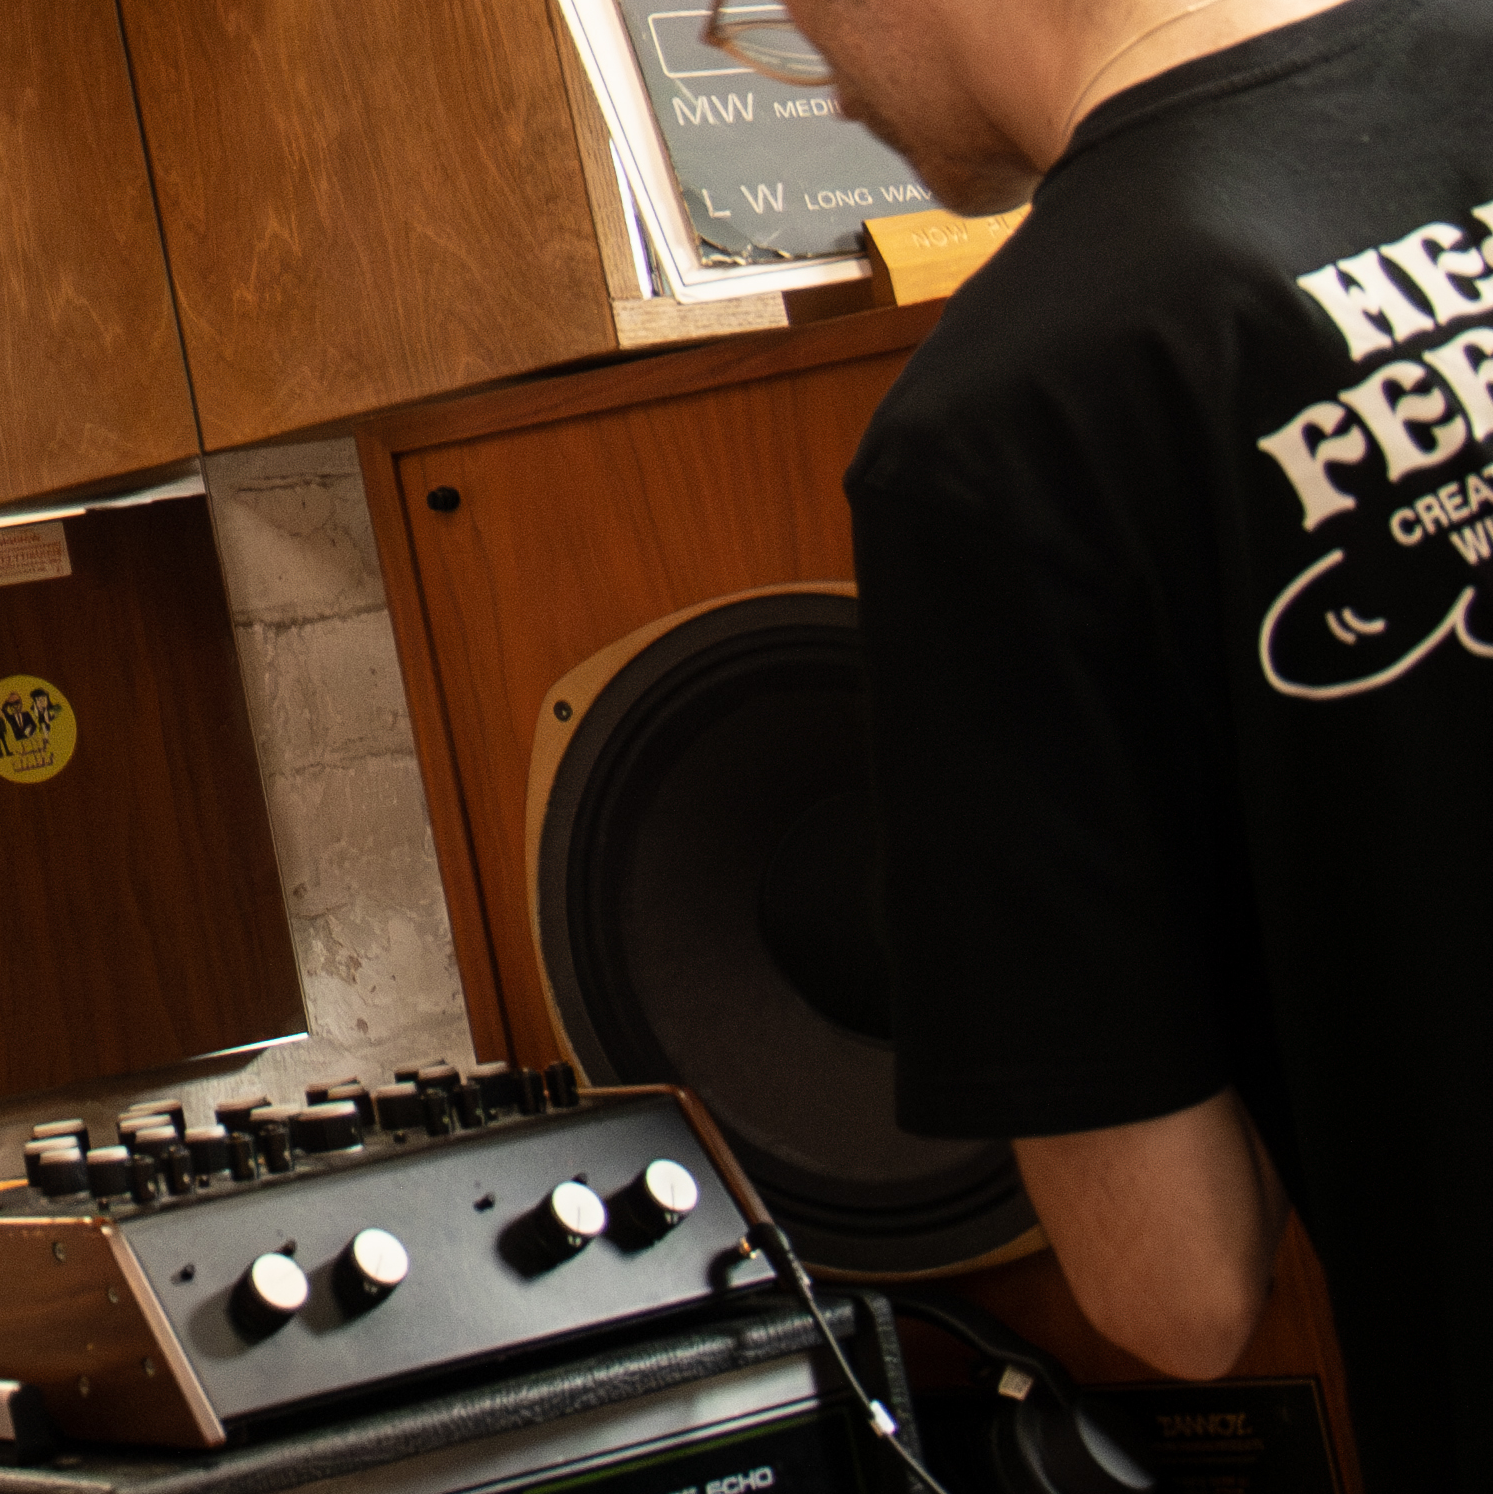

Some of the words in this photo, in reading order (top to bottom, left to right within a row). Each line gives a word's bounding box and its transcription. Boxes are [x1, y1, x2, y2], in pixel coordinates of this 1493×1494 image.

[671, 92, 754, 126] MW
[805, 187, 873, 211] LONG
[911, 223, 969, 248] NOW
[1296, 199, 1493, 363] HE
